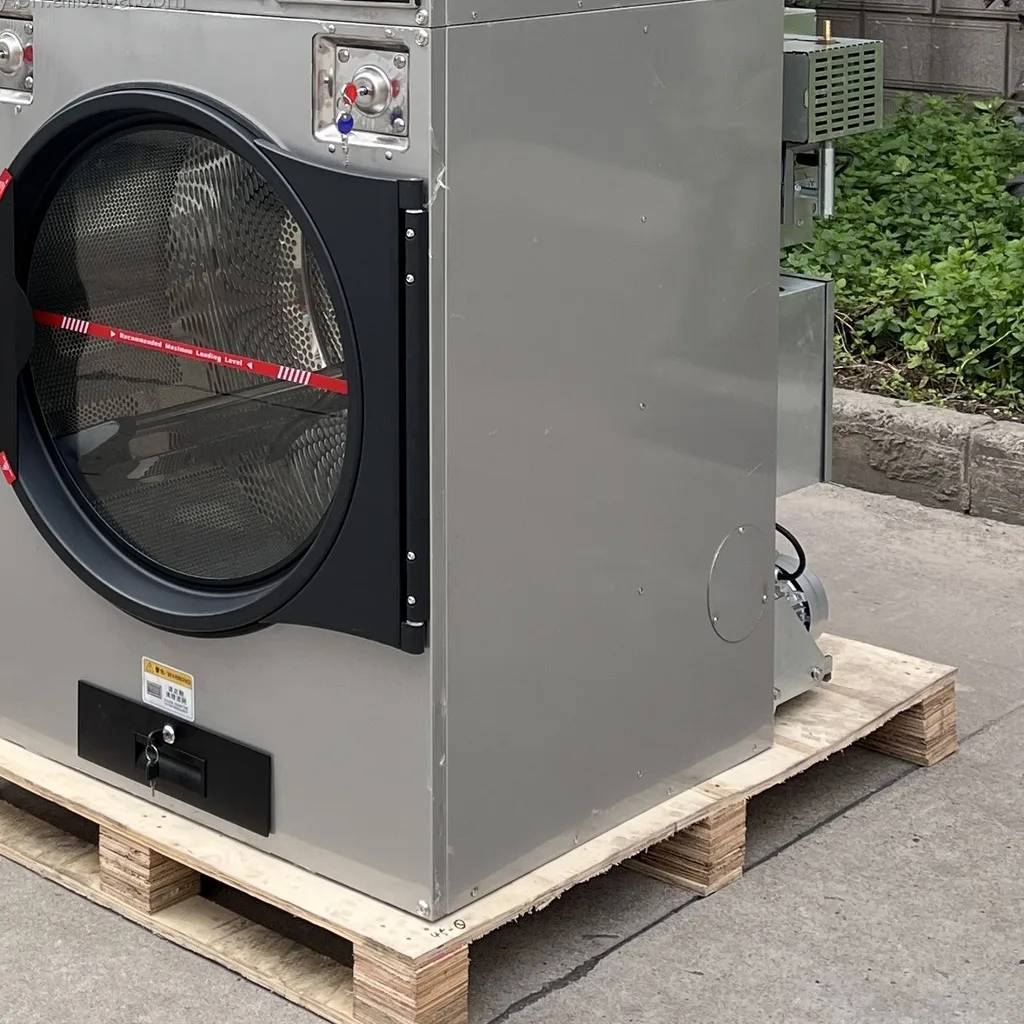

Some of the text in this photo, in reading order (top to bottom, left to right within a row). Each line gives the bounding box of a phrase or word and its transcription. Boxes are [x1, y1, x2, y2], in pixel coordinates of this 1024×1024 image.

[119, 332, 243, 366] Recommended Maximum Loading Level
